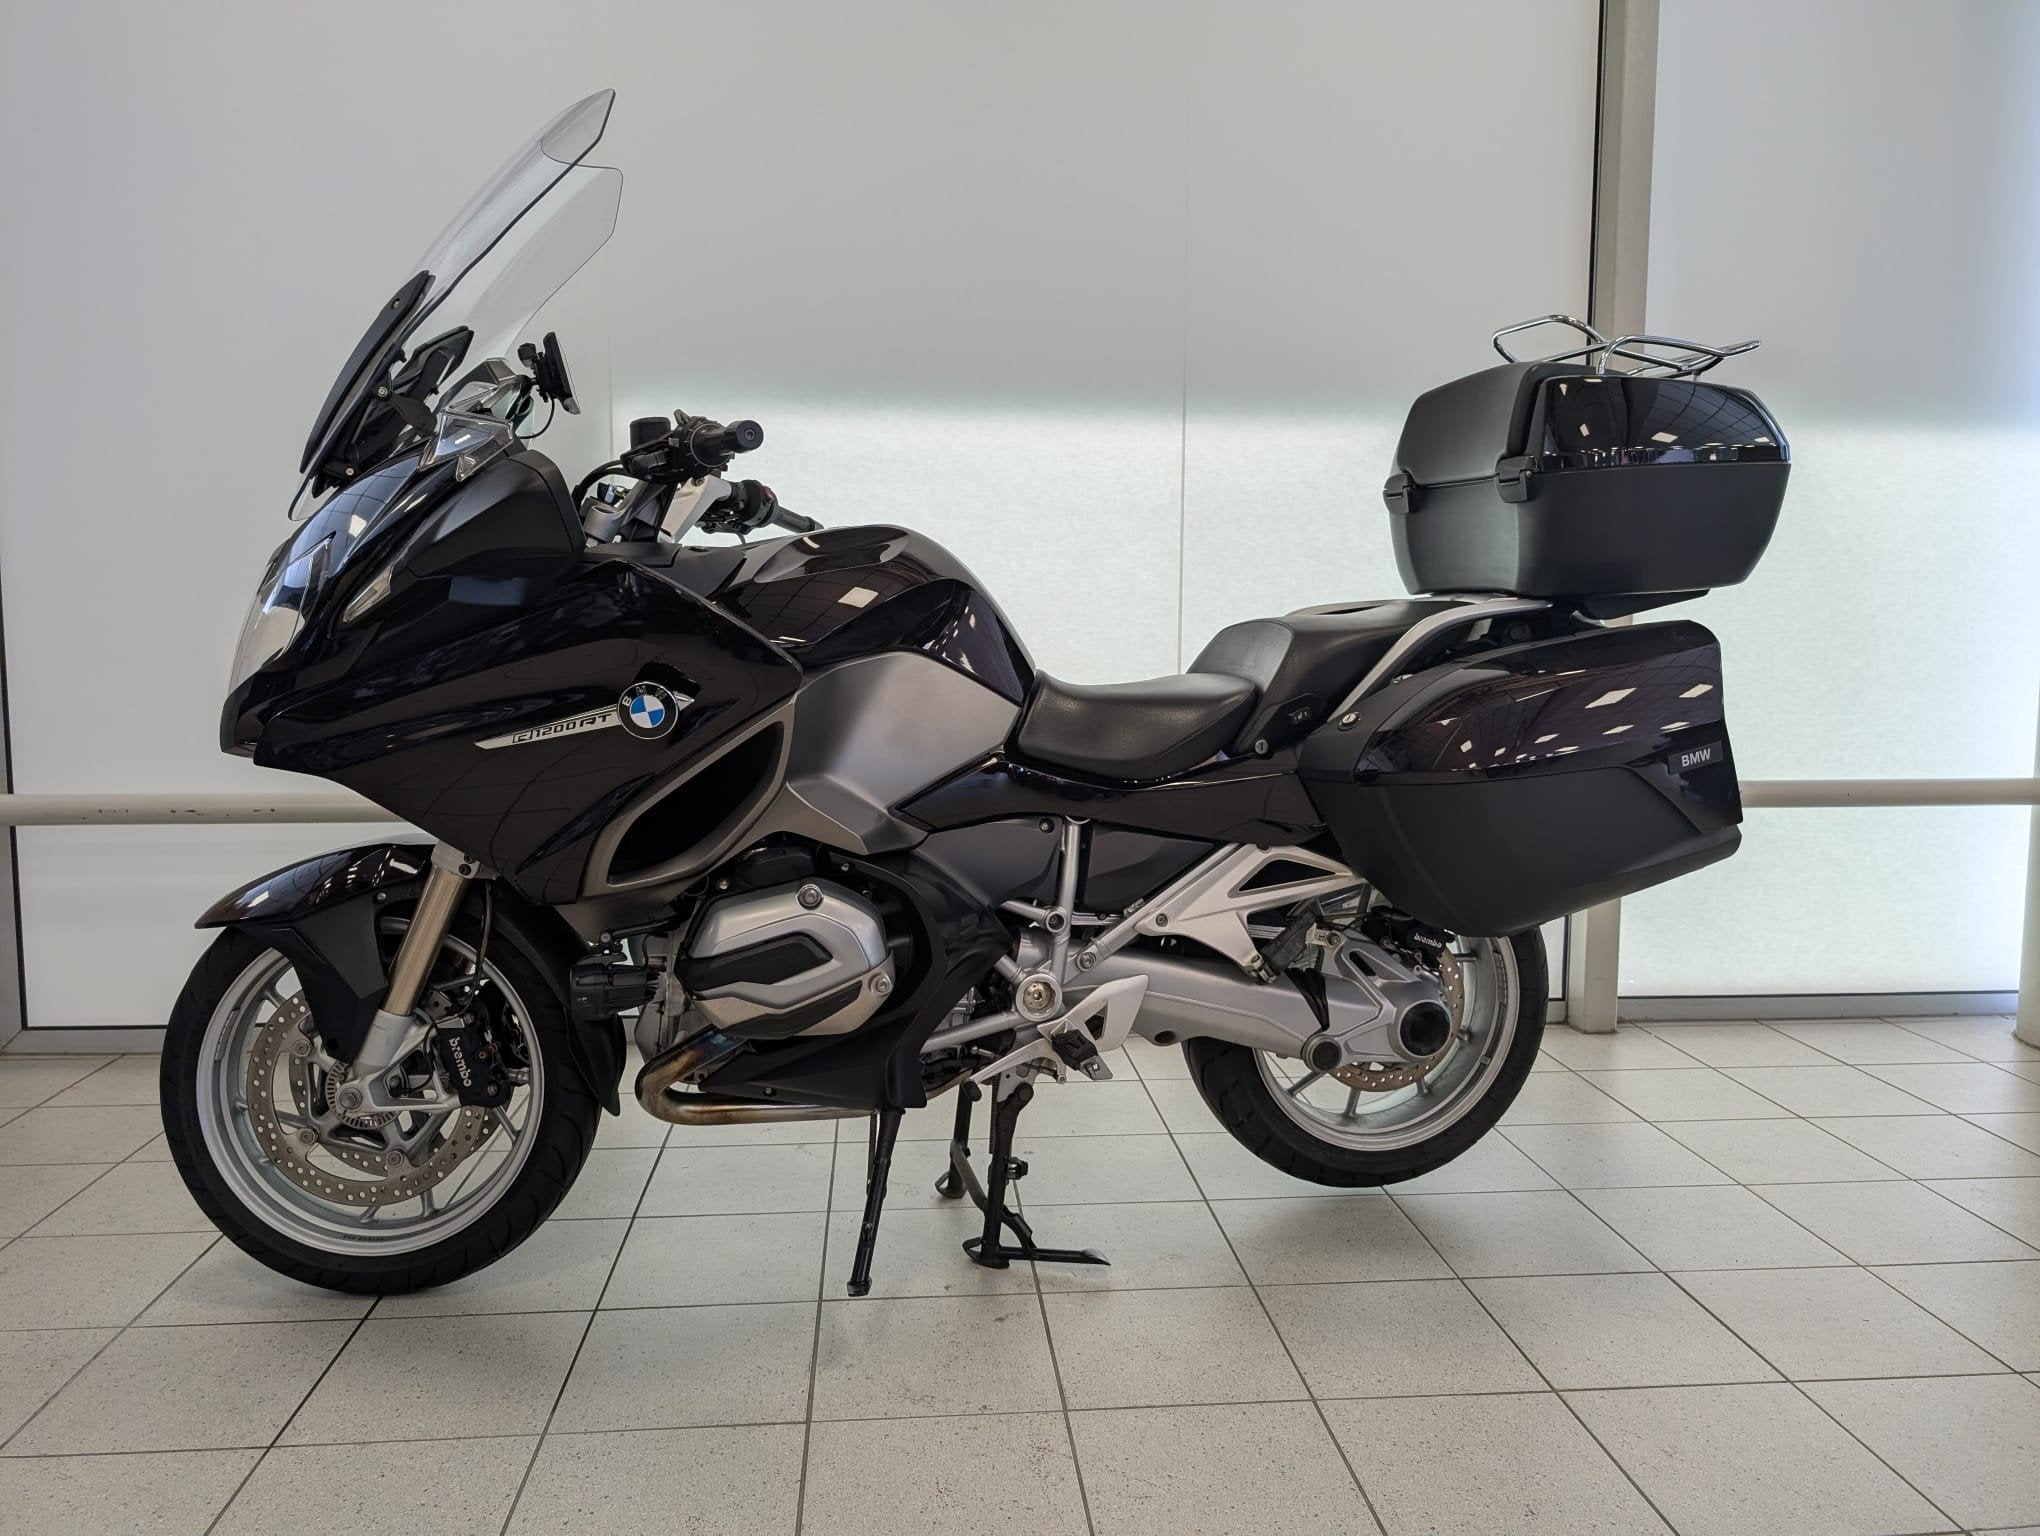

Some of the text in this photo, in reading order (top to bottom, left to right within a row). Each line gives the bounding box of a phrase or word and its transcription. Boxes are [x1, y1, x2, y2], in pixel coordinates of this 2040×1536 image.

[1681, 747, 1711, 768] BMW
[1413, 932, 1442, 948] brembo
[448, 1036, 472, 1087] brembo
